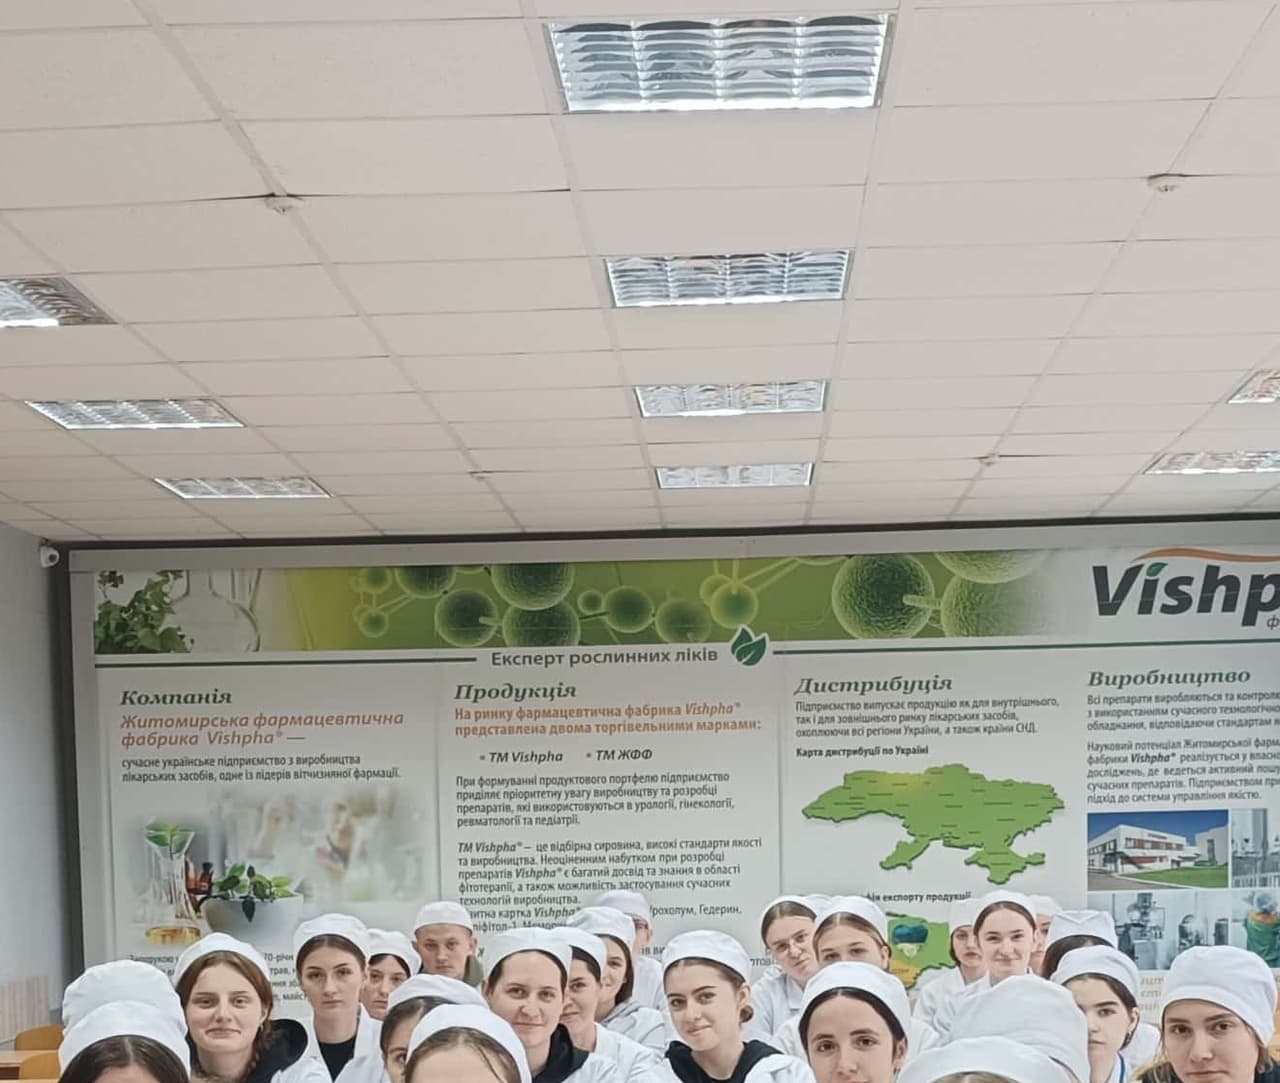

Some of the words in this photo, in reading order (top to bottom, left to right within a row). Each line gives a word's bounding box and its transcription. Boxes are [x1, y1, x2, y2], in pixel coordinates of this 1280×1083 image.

[492, 652, 564, 668] Експерт
[569, 651, 670, 667] рослинних
[676, 647, 717, 662] ліків
[456, 682, 576, 703] Продукція
[796, 674, 951, 696] Дистрибуція
[122, 688, 231, 705] Компанія
[455, 707, 471, 720] На
[474, 710, 513, 722] ринку
[516, 706, 621, 721] фармацевтична
[625, 704, 681, 719] фабрика
[796, 701, 861, 713] Підприємство
[863, 701, 905, 712] випускає
[907, 698, 957, 712] продукцію
[959, 700, 970, 708] як
[972, 699, 989, 709] для
[120, 714, 249, 731] Житомирська
[253, 712, 403, 730] фармацевтична
[455, 722, 546, 738] представлена
[550, 724, 591, 736] двома
[595, 719, 693, 736] торгівельними
[796, 728, 850, 738] охоплюючи
[852, 726, 865, 736] всі
[866, 727, 901, 738] регіони
[953, 726, 981, 734] також
[983, 723, 1014, 736] країни
[122, 731, 199, 750] фабрика
[512, 750, 563, 765] Vishpha
[618, 749, 653, 760] ЖФФ
[796, 748, 823, 758] Карта
[825, 746, 880, 758] дистрибуції
[896, 745, 929, 757] Україні
[122, 759, 160, 770] сучасне
[162, 756, 215, 770] українське
[217, 755, 286, 769] підприємство
[296, 754, 361, 768] виробництва
[122, 772, 176, 783] лікарських
[219, 772, 243, 782] одне
[245, 769, 253, 780] із
[256, 769, 291, 782] лідерів
[293, 768, 351, 779] вітчизняної
[456, 776, 475, 789] При
[478, 775, 537, 789] формуванні
[539, 776, 607, 788] продуктового
[609, 772, 659, 786] портфелю
[660, 772, 730, 784] підприємство
[516, 802, 531, 812] які
[533, 802, 624, 814] використовуються
[457, 815, 521, 829] ревматології
[523, 817, 533, 826] та
[536, 843, 548, 853] це
[550, 840, 592, 853] відбірна
[646, 839, 677, 850] високі
[679, 839, 730, 851] стандарти
[732, 837, 762, 848] якості
[540, 854, 606, 866] Неоціненним
[608, 852, 656, 866] набутком
[659, 854, 677, 865] при
[680, 850, 725, 865] розробці
[526, 883, 555, 892] також
[558, 880, 616, 891] можливість
[619, 880, 684, 892] застосування
[686, 880, 730, 890] сучасних
[460, 895, 511, 906] технологій
[882, 894, 924, 903] експорту
[470, 910, 496, 919] итна
[498, 910, 531, 920] картка
